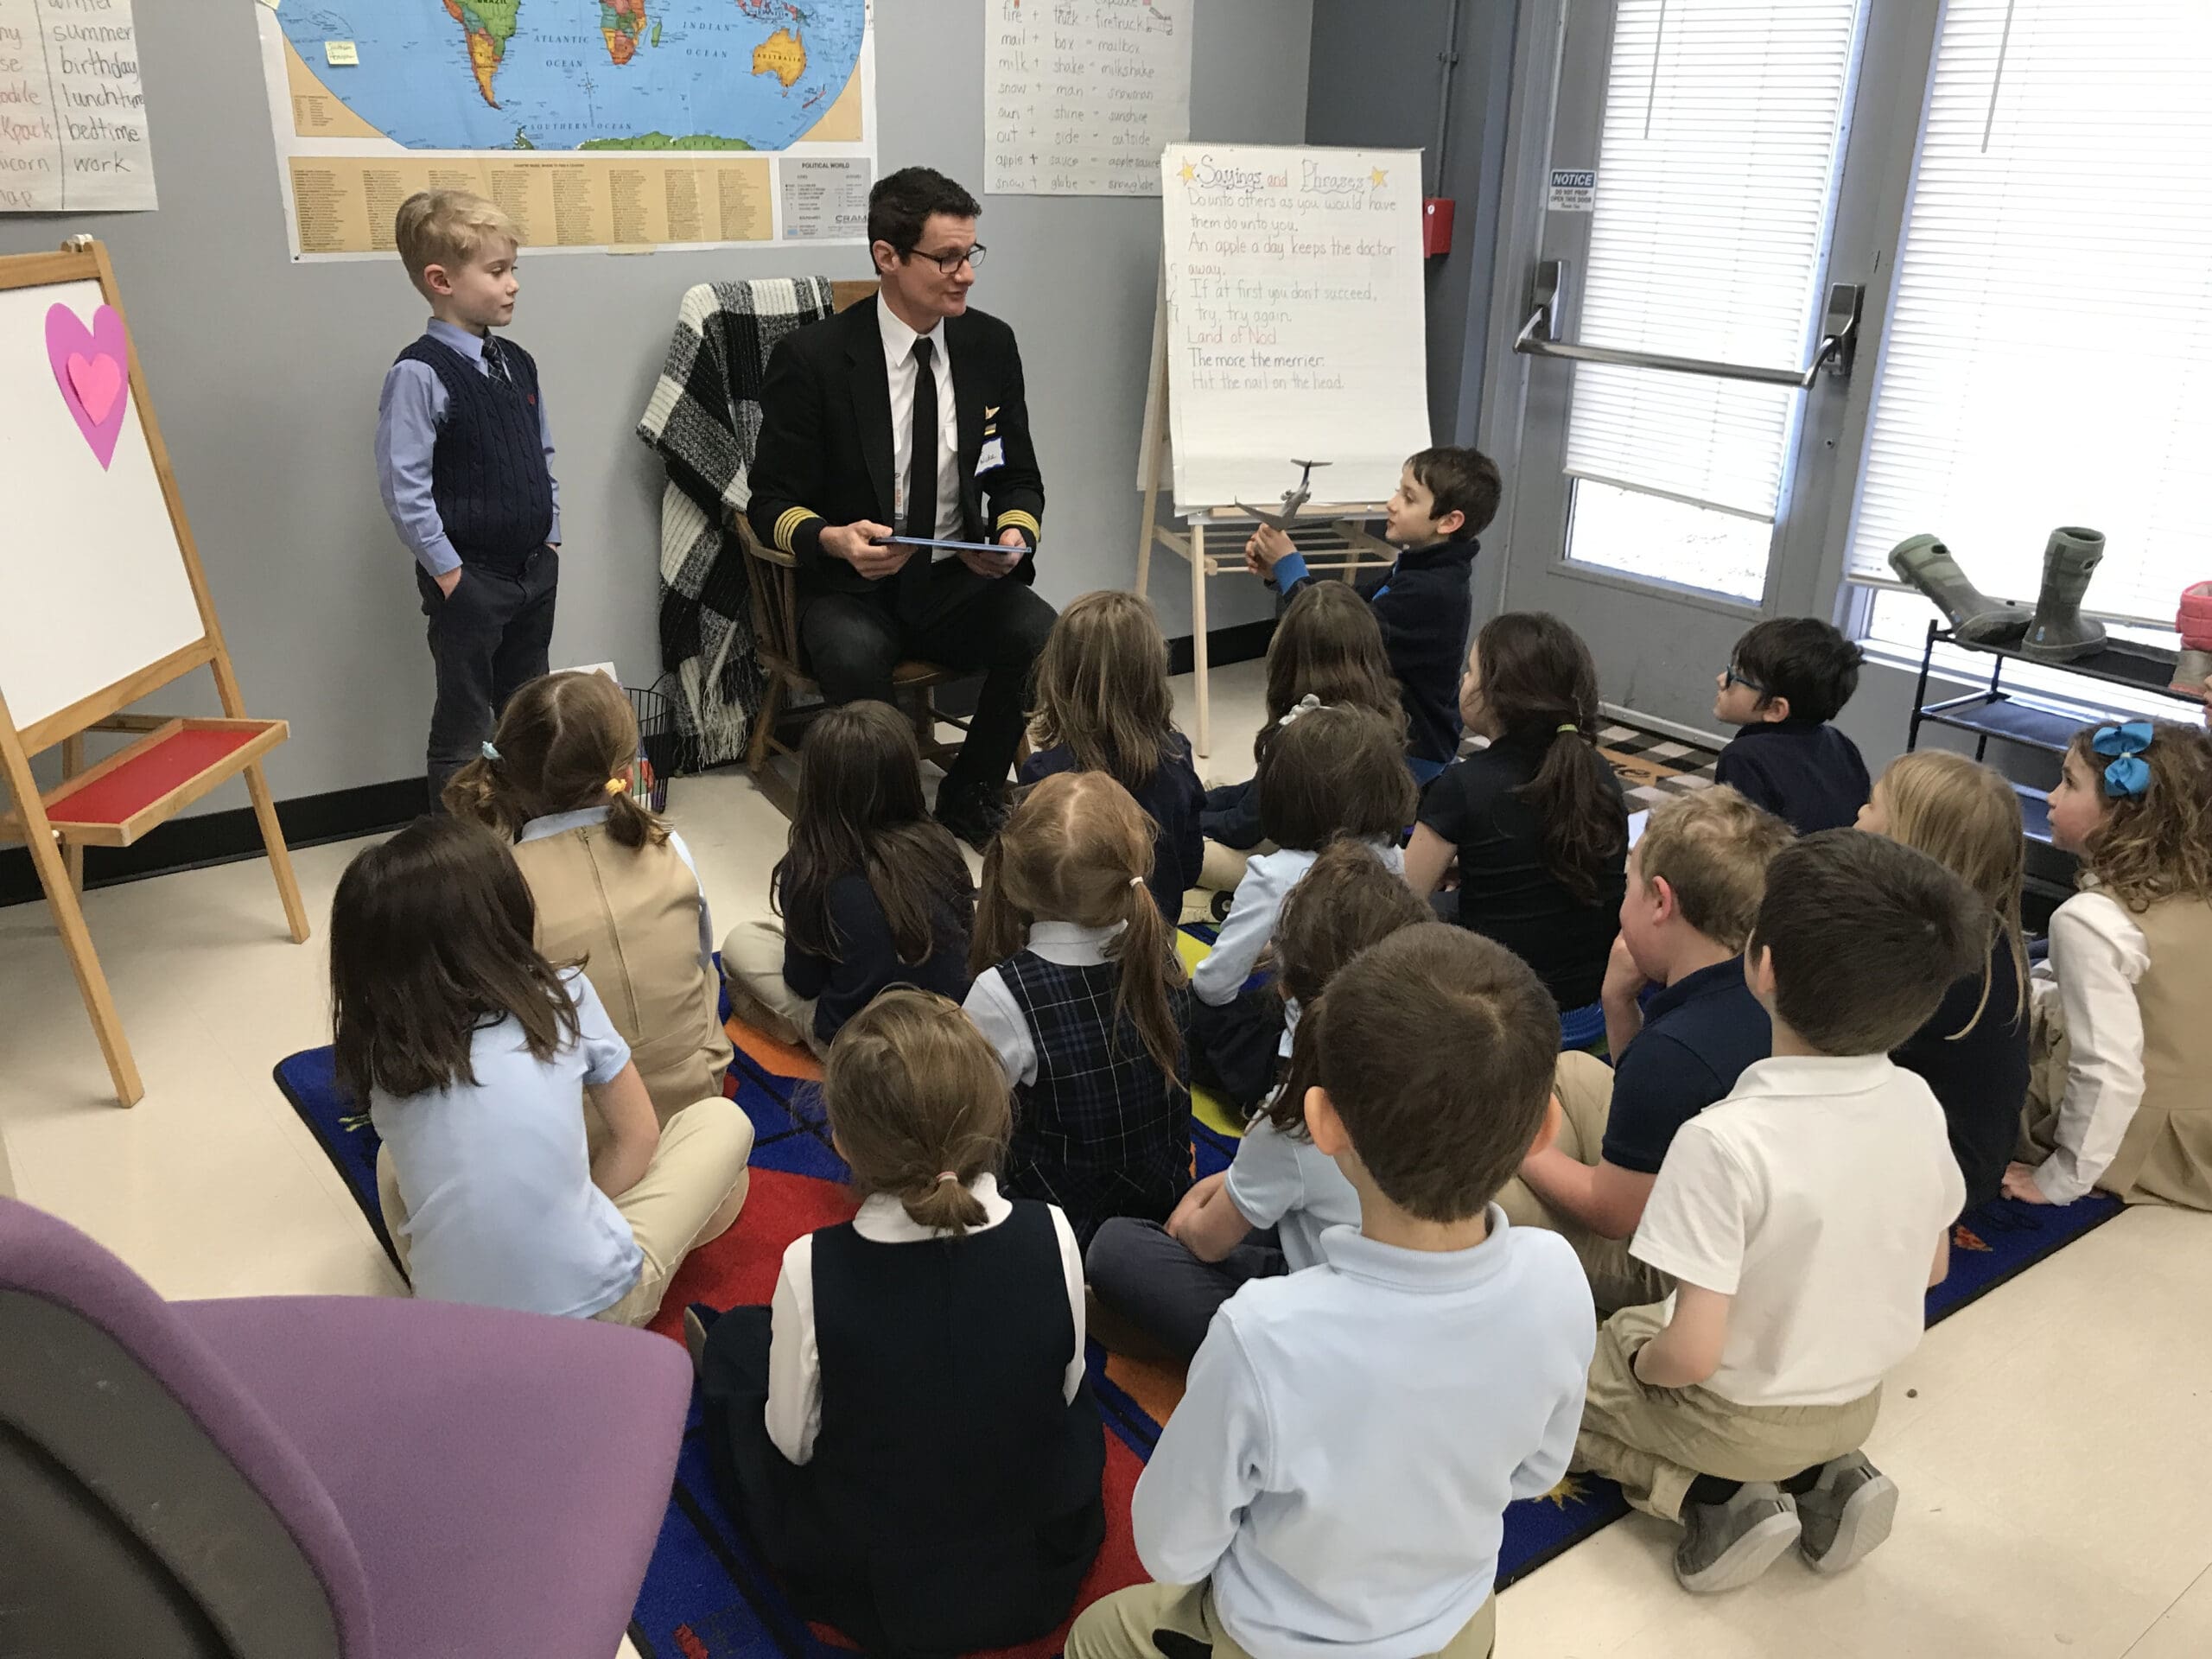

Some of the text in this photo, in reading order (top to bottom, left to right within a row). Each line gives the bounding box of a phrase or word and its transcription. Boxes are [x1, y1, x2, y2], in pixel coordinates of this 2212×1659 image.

[683, 21, 730, 31] INDIAN
[1002, 2, 1023, 23] fire
[1053, 5, 1079, 26] truck
[1095, 8, 1142, 32] firetruck
[53, 24, 132, 42] summer
[534, 35, 589, 44] ATLANTIC
[1001, 28, 1026, 46] mail
[1054, 32, 1074, 50] box
[1098, 38, 1140, 54] mailbox
[686, 48, 728, 58] OCEAN
[60, 45, 138, 84] birthday
[999, 50, 1027, 72] milk
[1054, 57, 1084, 75] shake
[1102, 57, 1154, 78] milkshake
[998, 83, 1027, 95] snow
[1057, 85, 1084, 97] man
[999, 105, 1020, 119] sun
[64, 114, 141, 143] bedtime
[997, 124, 1019, 143] out
[1056, 127, 1079, 145] side
[1112, 129, 1151, 145] outside
[73, 150, 131, 173] work
[995, 153, 1023, 168] apple
[995, 176, 1024, 188] snow
[1052, 175, 1078, 189] globe
[1197, 154, 1364, 193] Sayings and Phrases
[1553, 173, 1592, 186] NOTICE
[1187, 187, 1396, 216] Do unto others as you would have
[1191, 212, 1299, 238] them do unto you.
[1188, 232, 1397, 260] An apple a day keeps the doctor
[1188, 264, 1226, 283] away.
[1190, 277, 1209, 298] If
[1216, 280, 1230, 298] at
[1237, 277, 1262, 300] first
[1268, 288, 1287, 306] you
[1226, 302, 1249, 327] try
[1253, 311, 1293, 328] again.
[1187, 325, 1276, 345] Land of Nod
[1187, 346, 1211, 367] The
[1215, 355, 1246, 367] more
[1250, 348, 1271, 367] the
[1192, 370, 1215, 390] Hit
[1220, 371, 1240, 390] the
[1244, 371, 1268, 390] nail
[1273, 378, 1287, 390] on
[1292, 371, 1309, 389] the
